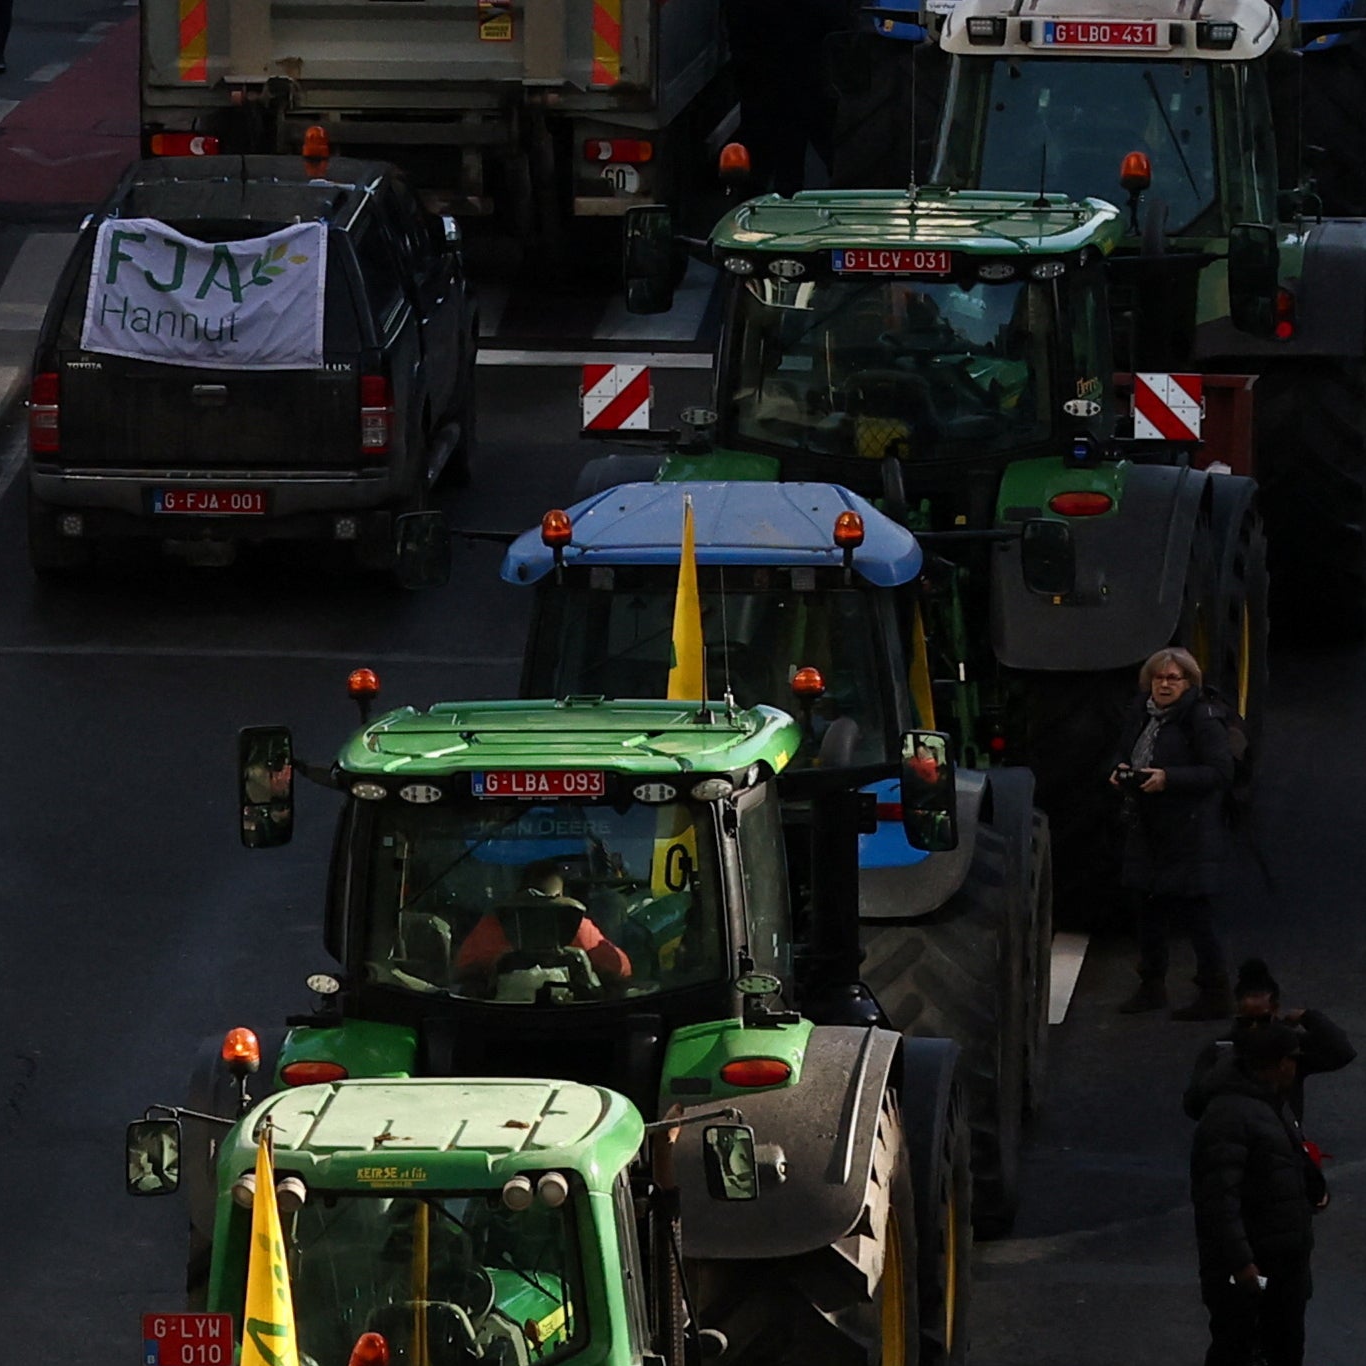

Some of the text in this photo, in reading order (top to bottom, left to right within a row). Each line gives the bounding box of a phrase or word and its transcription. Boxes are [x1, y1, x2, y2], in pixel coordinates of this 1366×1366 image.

[1055, 25, 1153, 43] G-LBO-431
[106, 230, 243, 303] FJA
[844, 251, 947, 269] G-LCV-031
[100, 293, 239, 343] Hannut
[65, 361, 104, 370] TOYOTA
[164, 492, 263, 510] G-FJA-001
[486, 773, 601, 792] G-LBA-093
[154, 1318, 220, 1338] G-LYW
[181, 1344, 221, 1364] 010
